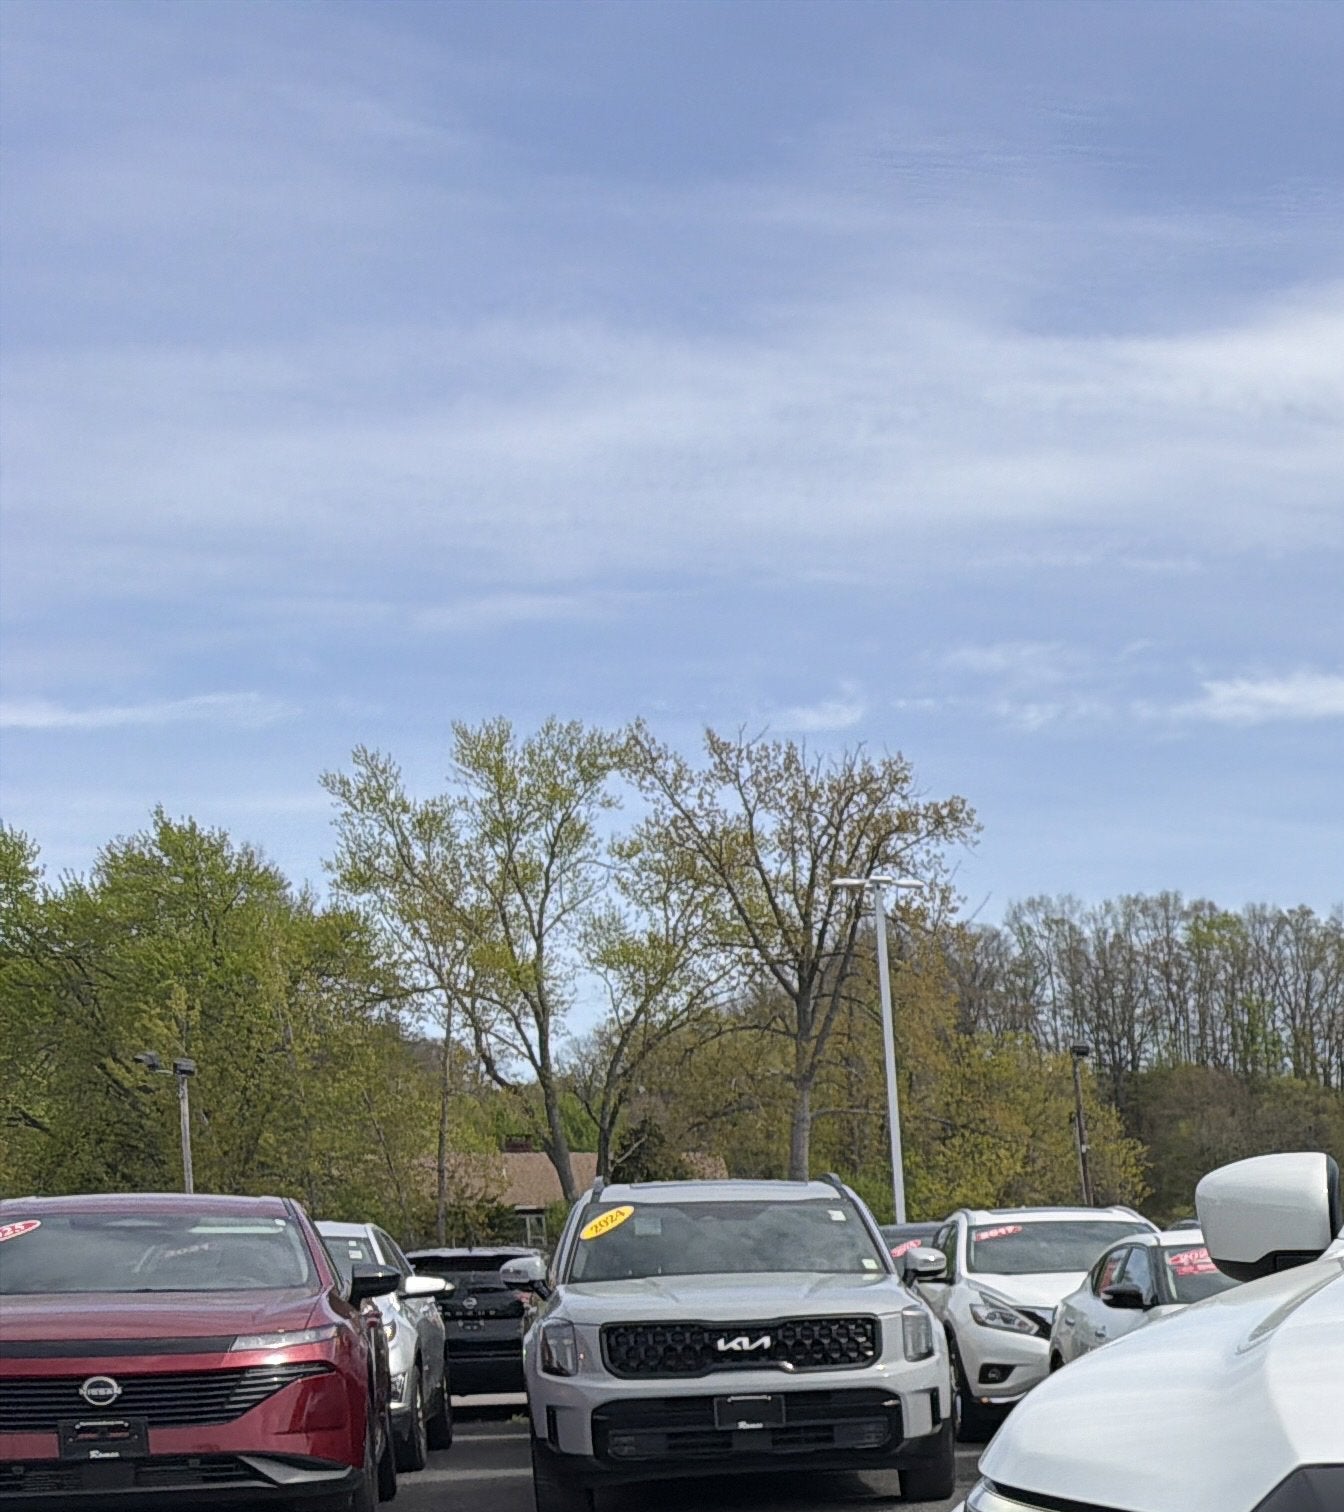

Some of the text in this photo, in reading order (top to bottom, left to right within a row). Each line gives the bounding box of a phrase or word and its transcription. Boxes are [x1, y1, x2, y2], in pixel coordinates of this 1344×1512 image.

[590, 1210, 625, 1234] 2024
[0, 1225, 25, 1238] 25
[717, 1336, 771, 1351] KIA
